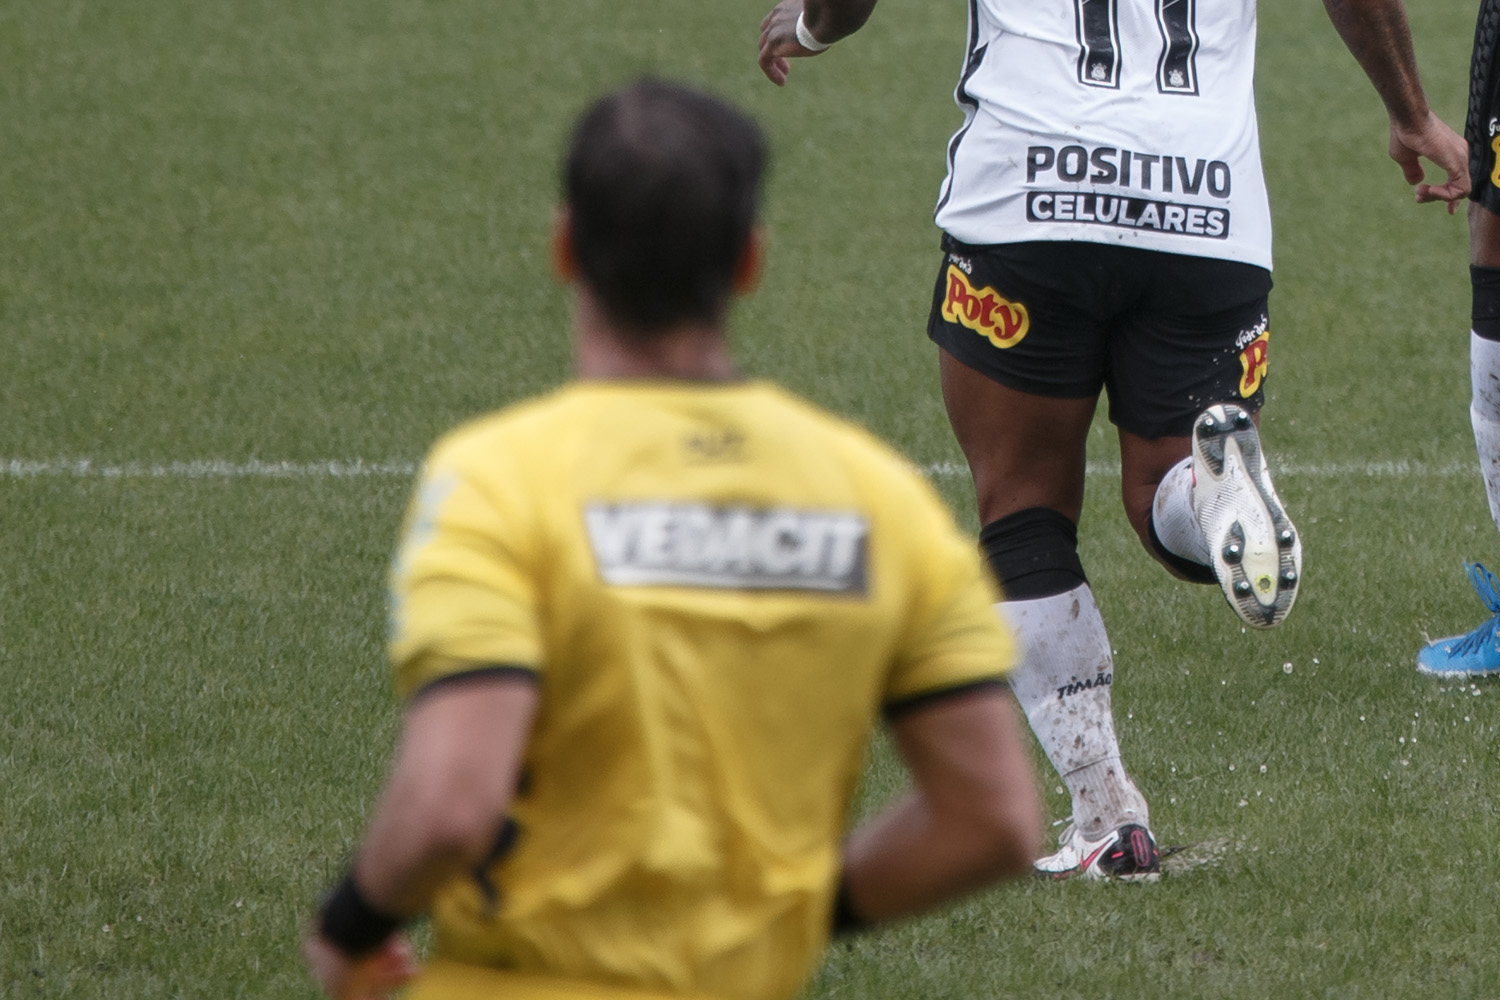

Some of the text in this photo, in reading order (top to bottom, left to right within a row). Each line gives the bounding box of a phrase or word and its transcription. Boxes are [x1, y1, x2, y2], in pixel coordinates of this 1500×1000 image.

[1025, 145, 1232, 200] POSITIVO
[1029, 193, 1228, 238] CELULARES
[945, 270, 1025, 342] Poty
[1056, 671, 1113, 701] TIMÃO
